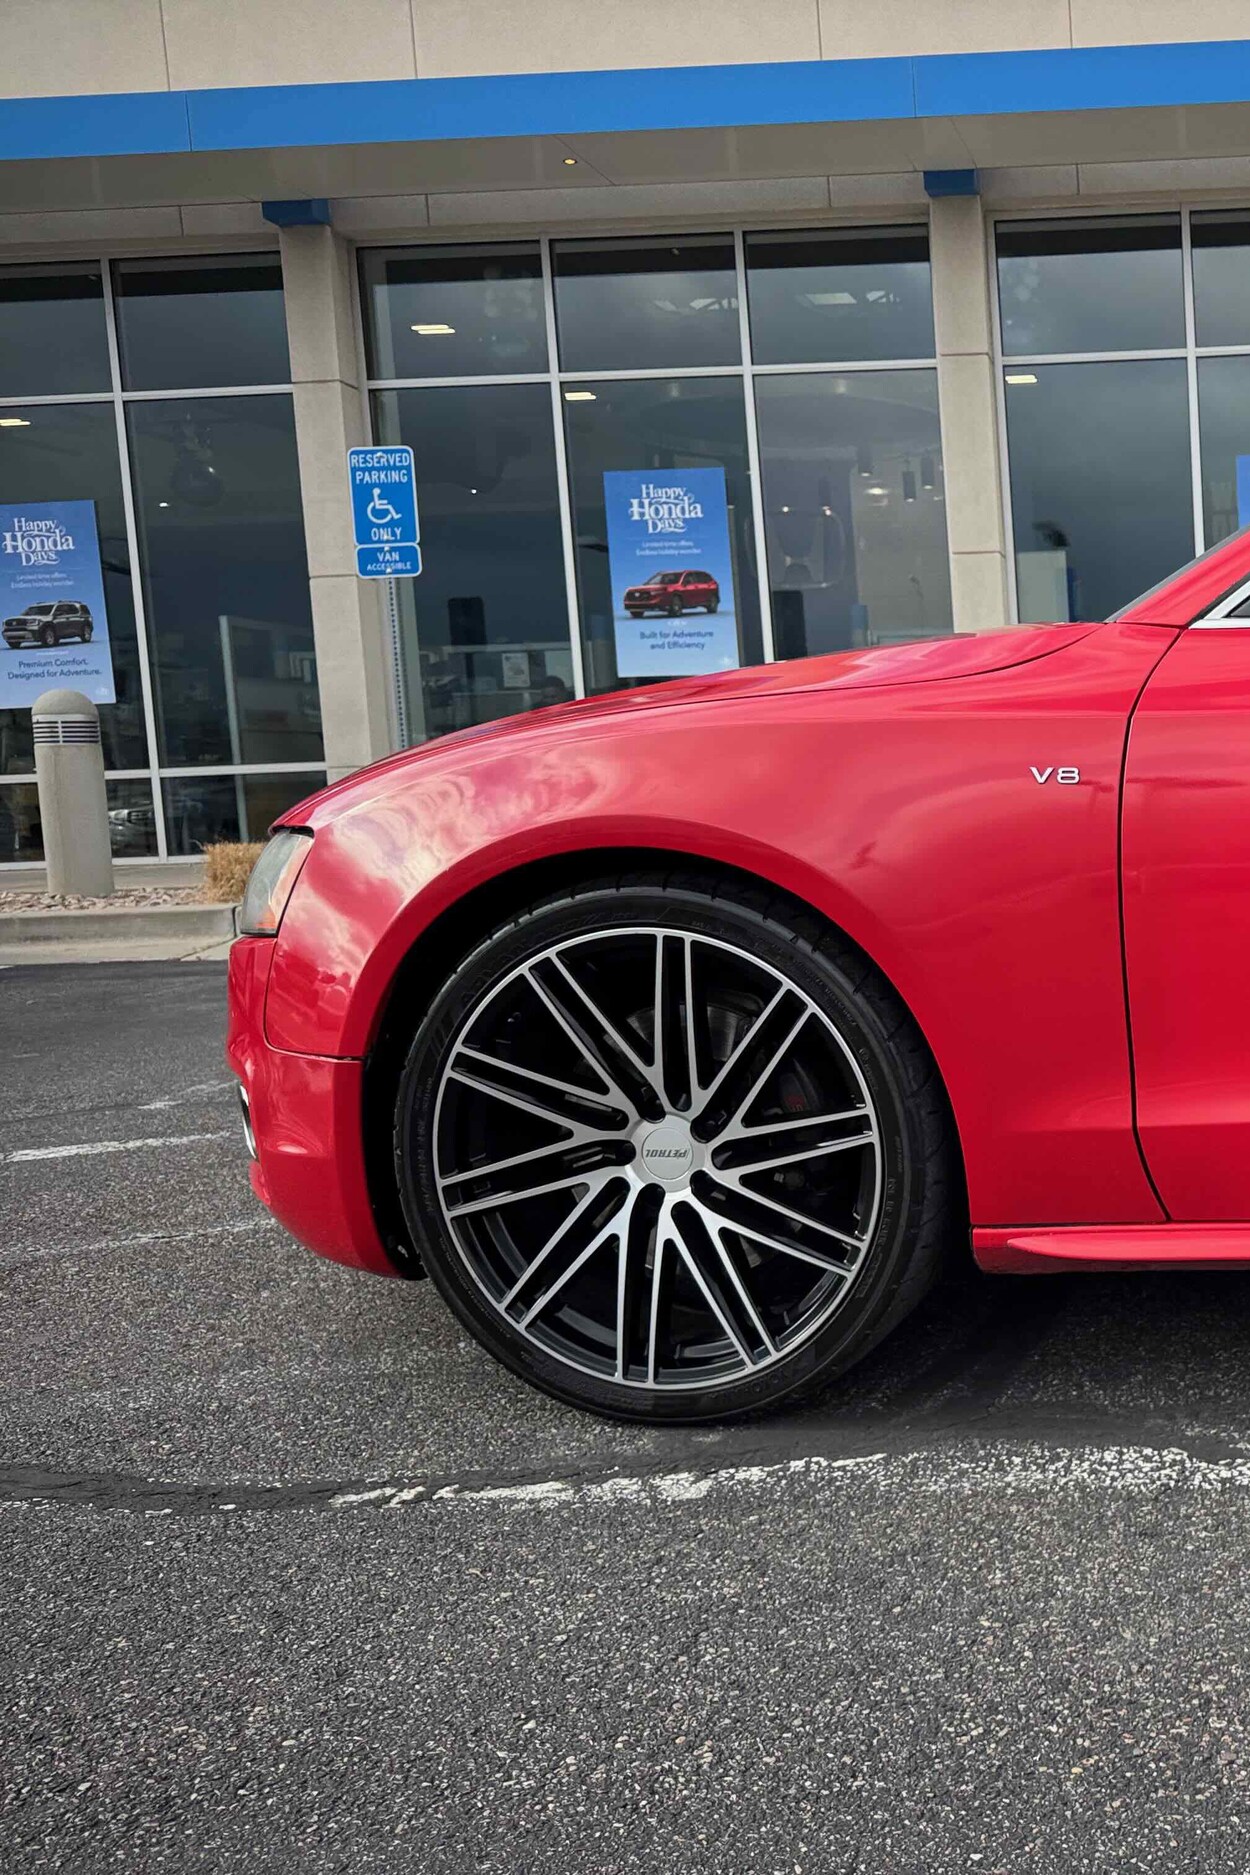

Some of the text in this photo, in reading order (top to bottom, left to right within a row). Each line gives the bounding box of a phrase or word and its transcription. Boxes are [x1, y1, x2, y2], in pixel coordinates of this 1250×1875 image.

[351, 452, 410, 467] RESERVED
[355, 470, 408, 484] PARKING
[641, 484, 687, 500] Happy
[628, 495, 704, 520] Honda
[13, 517, 57, 533] Happy
[647, 518, 688, 534] Days
[2, 529, 75, 553] Honda
[371, 527, 402, 541] ONLY
[21, 551, 60, 567] Days
[376, 551, 399, 562] VAN
[366, 561, 412, 572] ACCESSIBLE
[640, 630, 714, 640] Built for Adventure
[650, 640, 705, 651] and Efficiency
[18, 660, 53, 669] Premium
[8, 668, 102, 681] Designed for Adventure.
[1029, 766, 1080, 784] V8
[645, 1148, 689, 1159] PETROL
